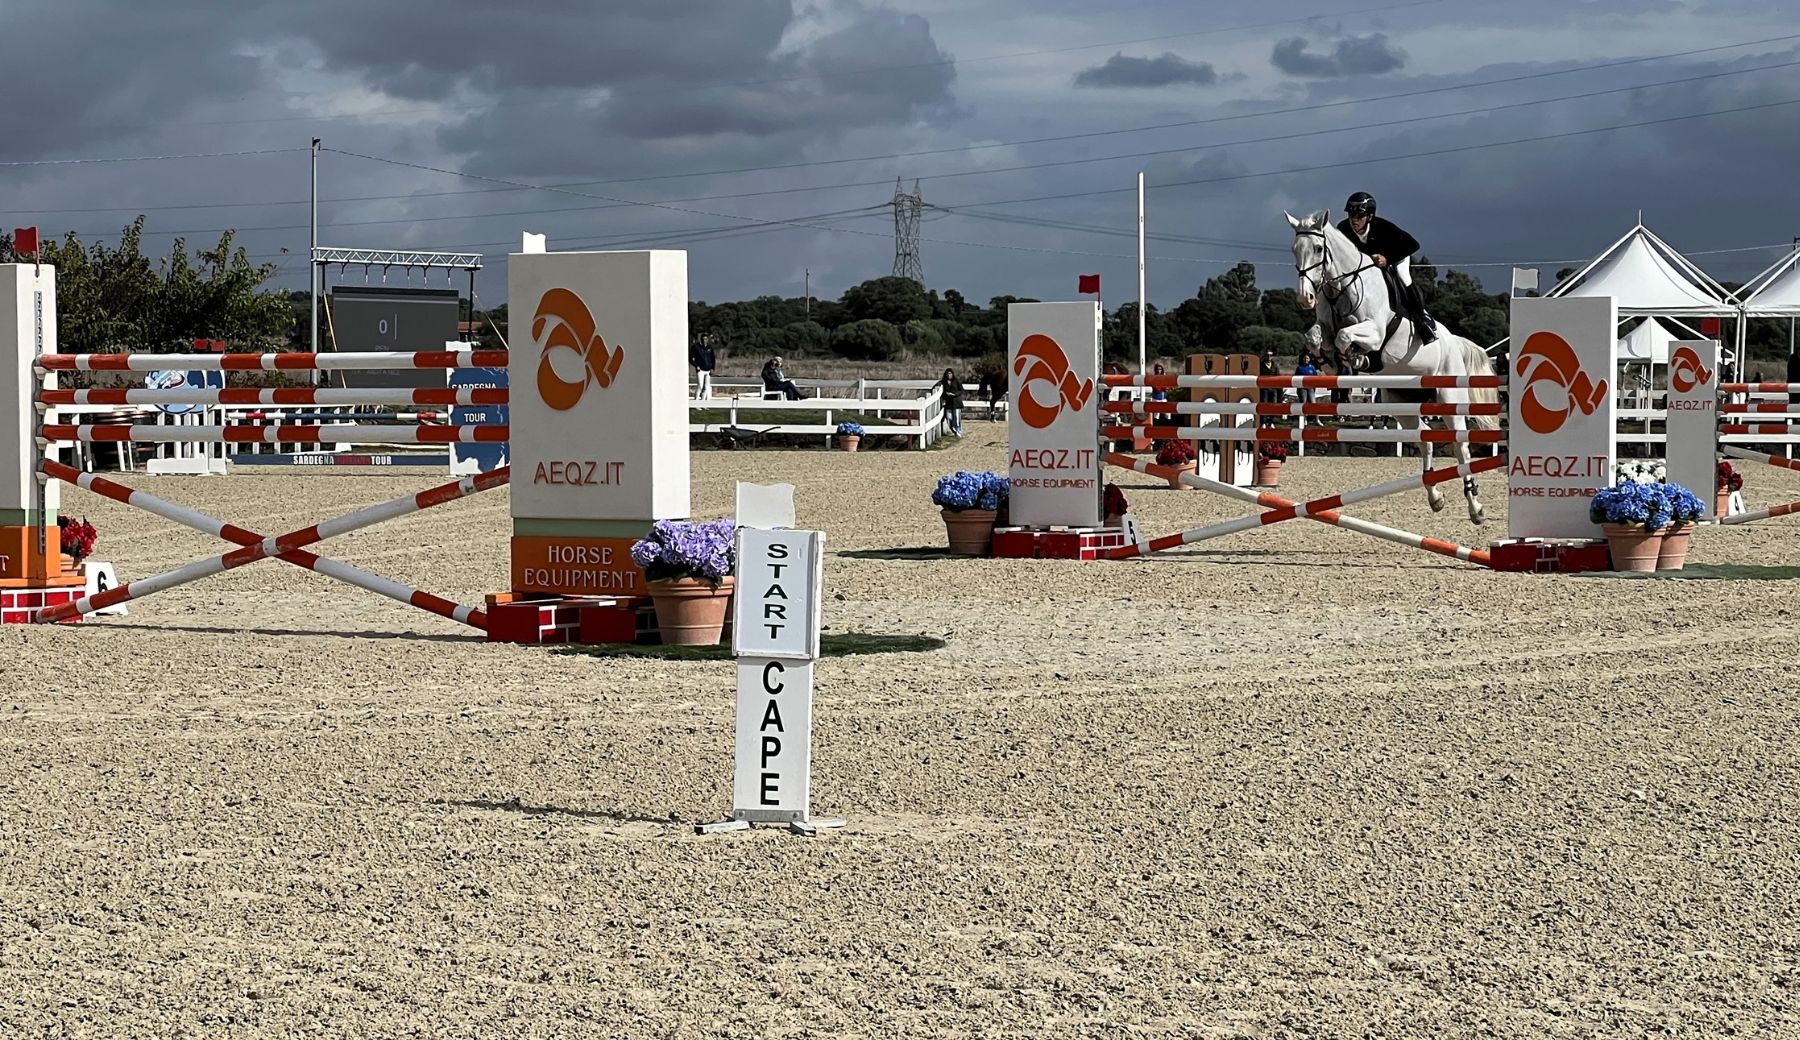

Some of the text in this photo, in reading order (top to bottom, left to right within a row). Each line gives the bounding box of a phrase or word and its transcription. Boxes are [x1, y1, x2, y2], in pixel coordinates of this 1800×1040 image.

[378, 319, 388, 334] 0
[1668, 400, 1713, 411] AEQZ.IT
[464, 412, 486, 422] TOUR
[293, 455, 335, 465] SARDEGNA
[371, 455, 392, 465] TOUR
[1010, 449, 1094, 470] AEQZ.IT
[1510, 455, 1608, 478] AEQZ.IT
[534, 461, 625, 486] AEQZ.IT
[1009, 478, 1095, 489] HORSE EQUIPMENT
[1509, 487, 1545, 497] HORSE
[548, 545, 613, 565] HORSE
[97, 570, 109, 593] 6
[524, 568, 637, 589] EQUIPMENT
[763, 543, 789, 640] START
[760, 661, 785, 806] CAPE
